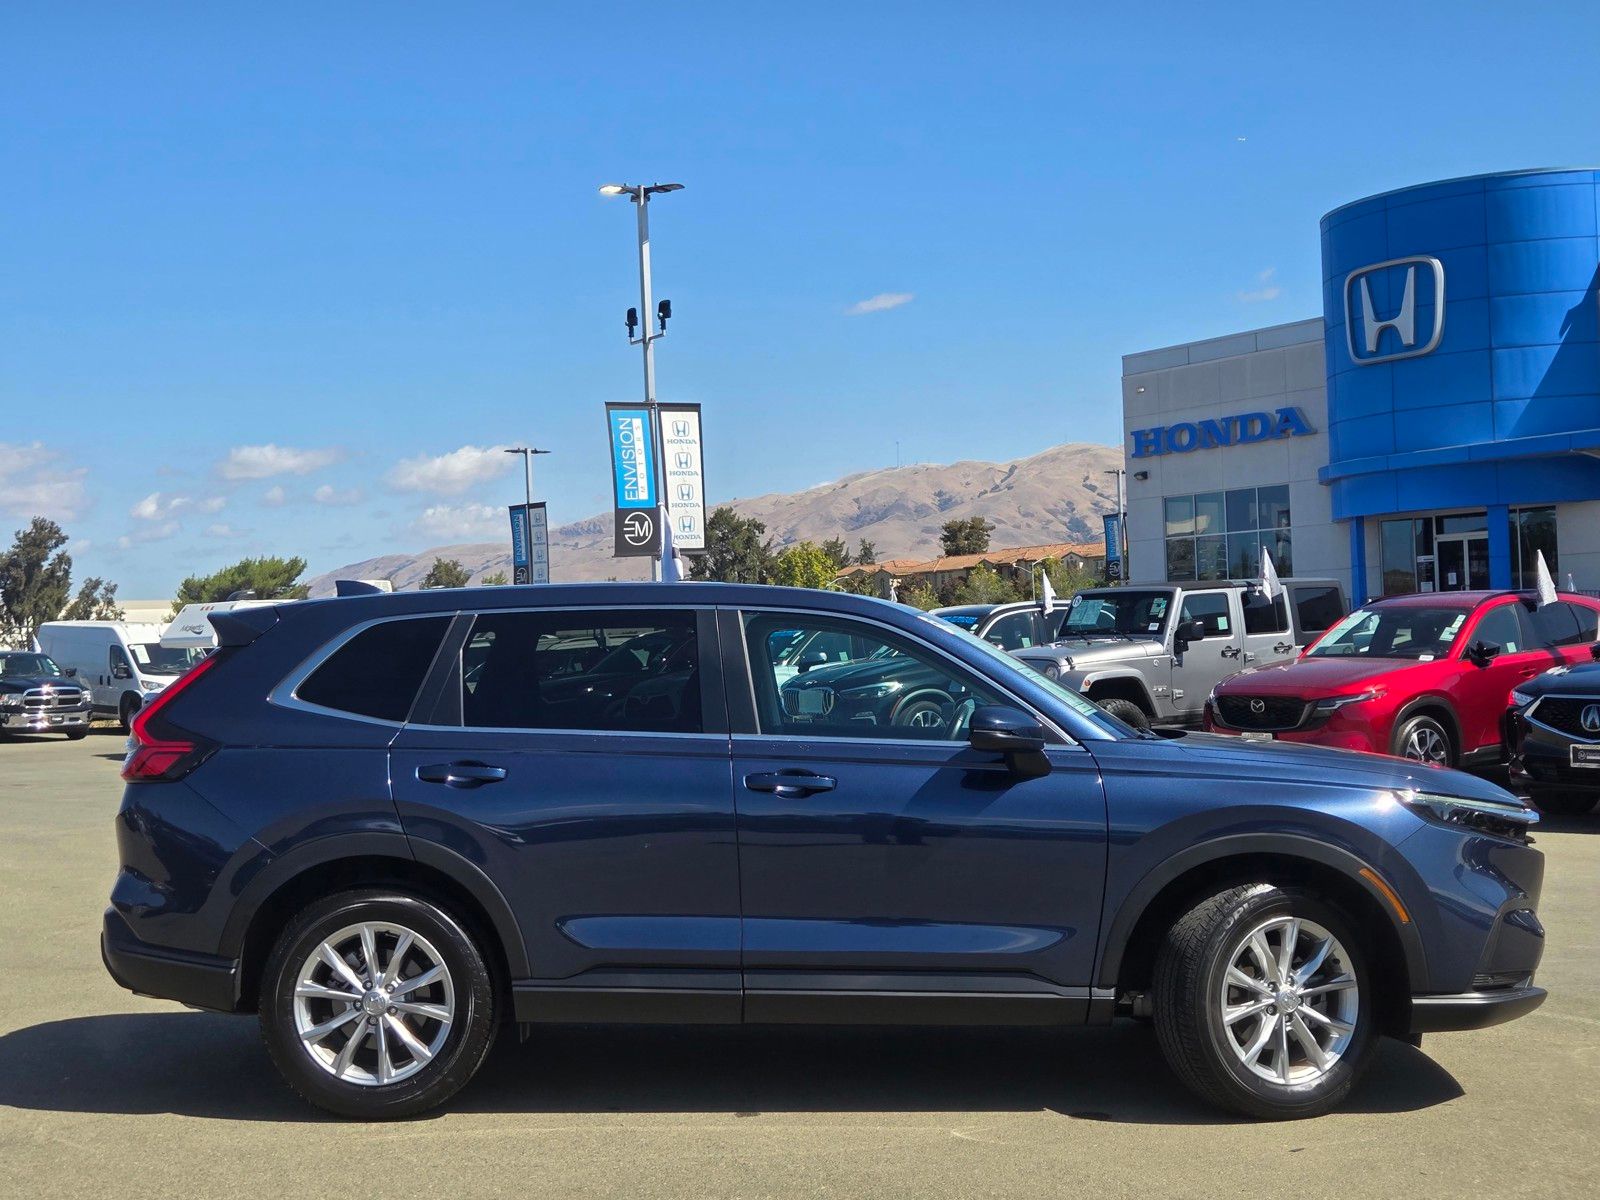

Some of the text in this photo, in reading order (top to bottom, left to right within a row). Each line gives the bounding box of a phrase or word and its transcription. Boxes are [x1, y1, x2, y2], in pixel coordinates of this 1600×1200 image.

[618, 417, 639, 500] ENVISION
[635, 425, 646, 493] MOTORS
[1130, 406, 1317, 458] HONDA
